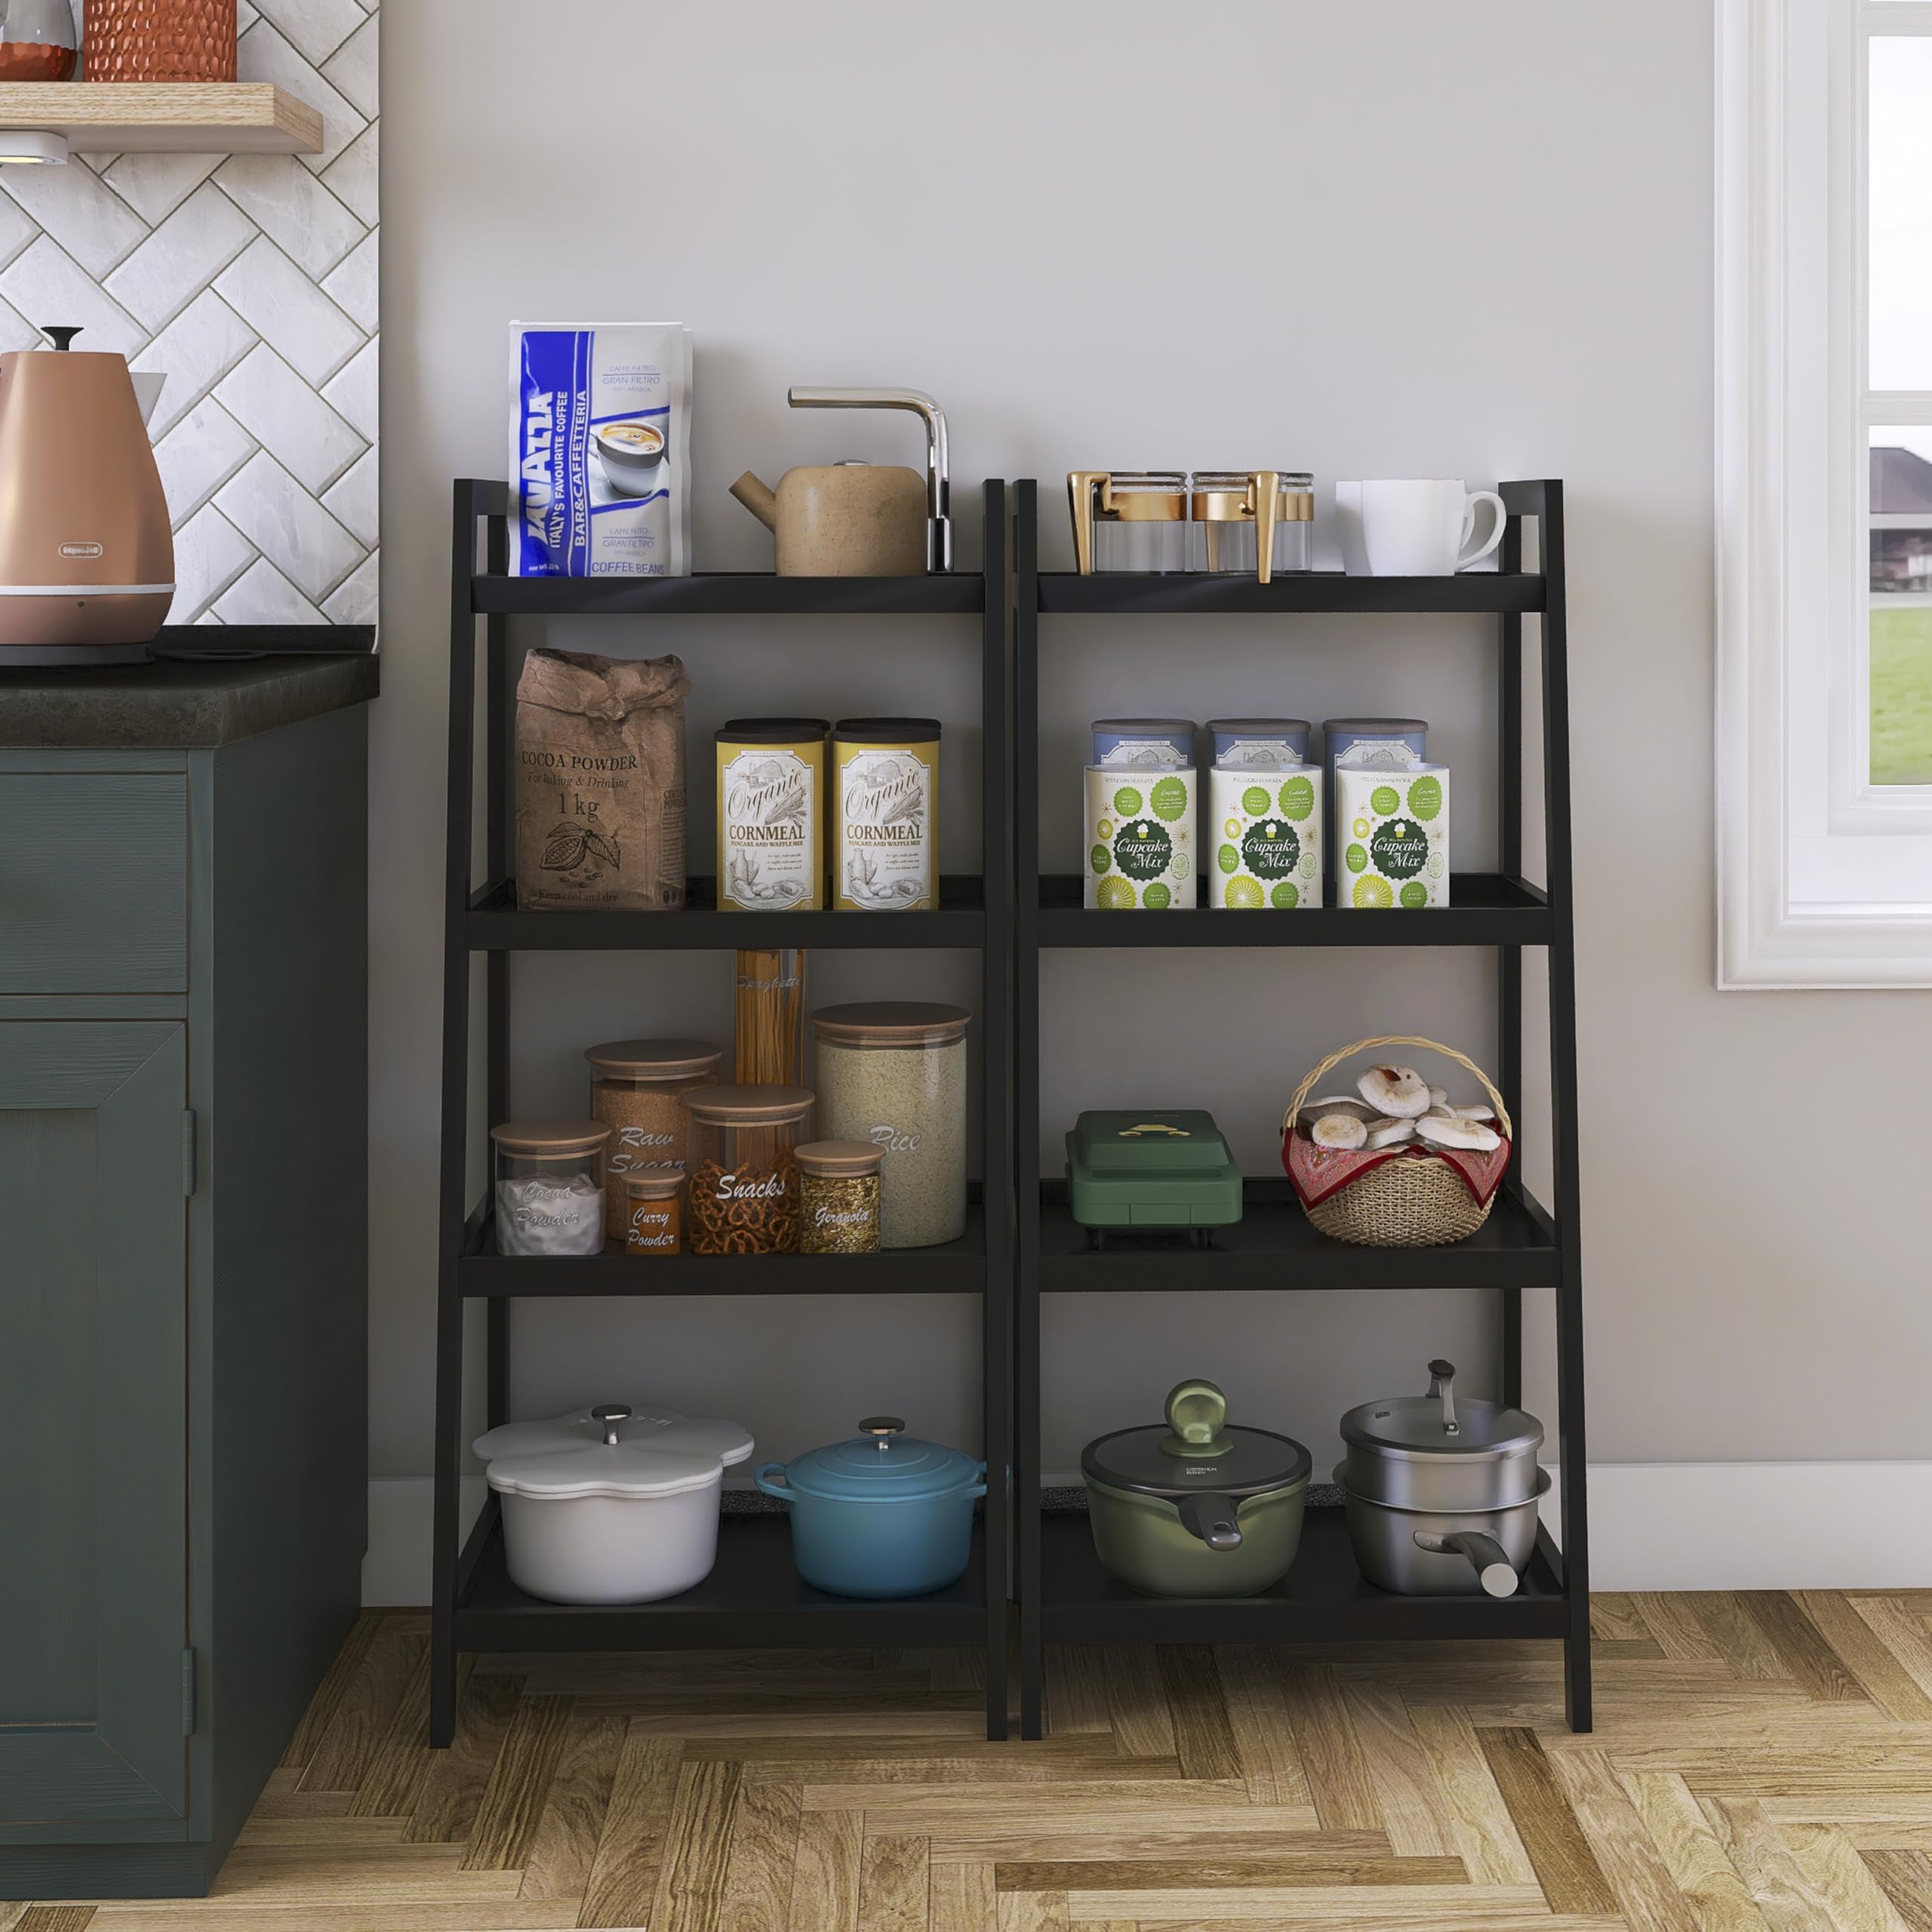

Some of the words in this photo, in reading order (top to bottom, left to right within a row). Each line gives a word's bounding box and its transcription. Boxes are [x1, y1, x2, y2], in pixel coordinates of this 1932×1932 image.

[603, 377, 629, 385] GRAN
[631, 377, 660, 385] FILTRO
[555, 391, 568, 432] COFFEE
[521, 392, 553, 544] LAVAZZA
[554, 435, 565, 499] FAVOURITE
[572, 390, 586, 547] BAR&CAFFETTERIA
[549, 503, 565, 549] ITALY'S
[628, 540, 654, 549] FILTRO
[592, 561, 635, 573] COFFEE
[635, 563, 665, 575] BEANS
[522, 750, 566, 768] COCOA
[571, 754, 638, 771] POWDER
[575, 776, 585, 786] &
[586, 776, 629, 789] Drinking
[727, 768, 802, 823] Organic
[845, 768, 919, 822] Organic
[559, 794, 567, 814] 1
[574, 793, 601, 823] kg
[729, 825, 806, 841] CORNMEAL
[847, 824, 923, 840] CORNMEAL
[1117, 838, 1168, 855] Cupcake
[1245, 837, 1297, 855] Cupcake
[1374, 836, 1426, 854] Cupcake
[1131, 853, 1164, 869] Mix
[1259, 853, 1292, 868] Mix
[1388, 852, 1421, 867] Mix
[619, 1126, 674, 1147] Raw
[869, 1125, 920, 1154] Rice
[522, 1180, 571, 1203] Cocoa
[715, 1173, 786, 1199] Snacks
[515, 1207, 580, 1226] Powder
[632, 1207, 669, 1227] Curry
[814, 1207, 870, 1227] Geranola
[627, 1229, 675, 1246] Powder
